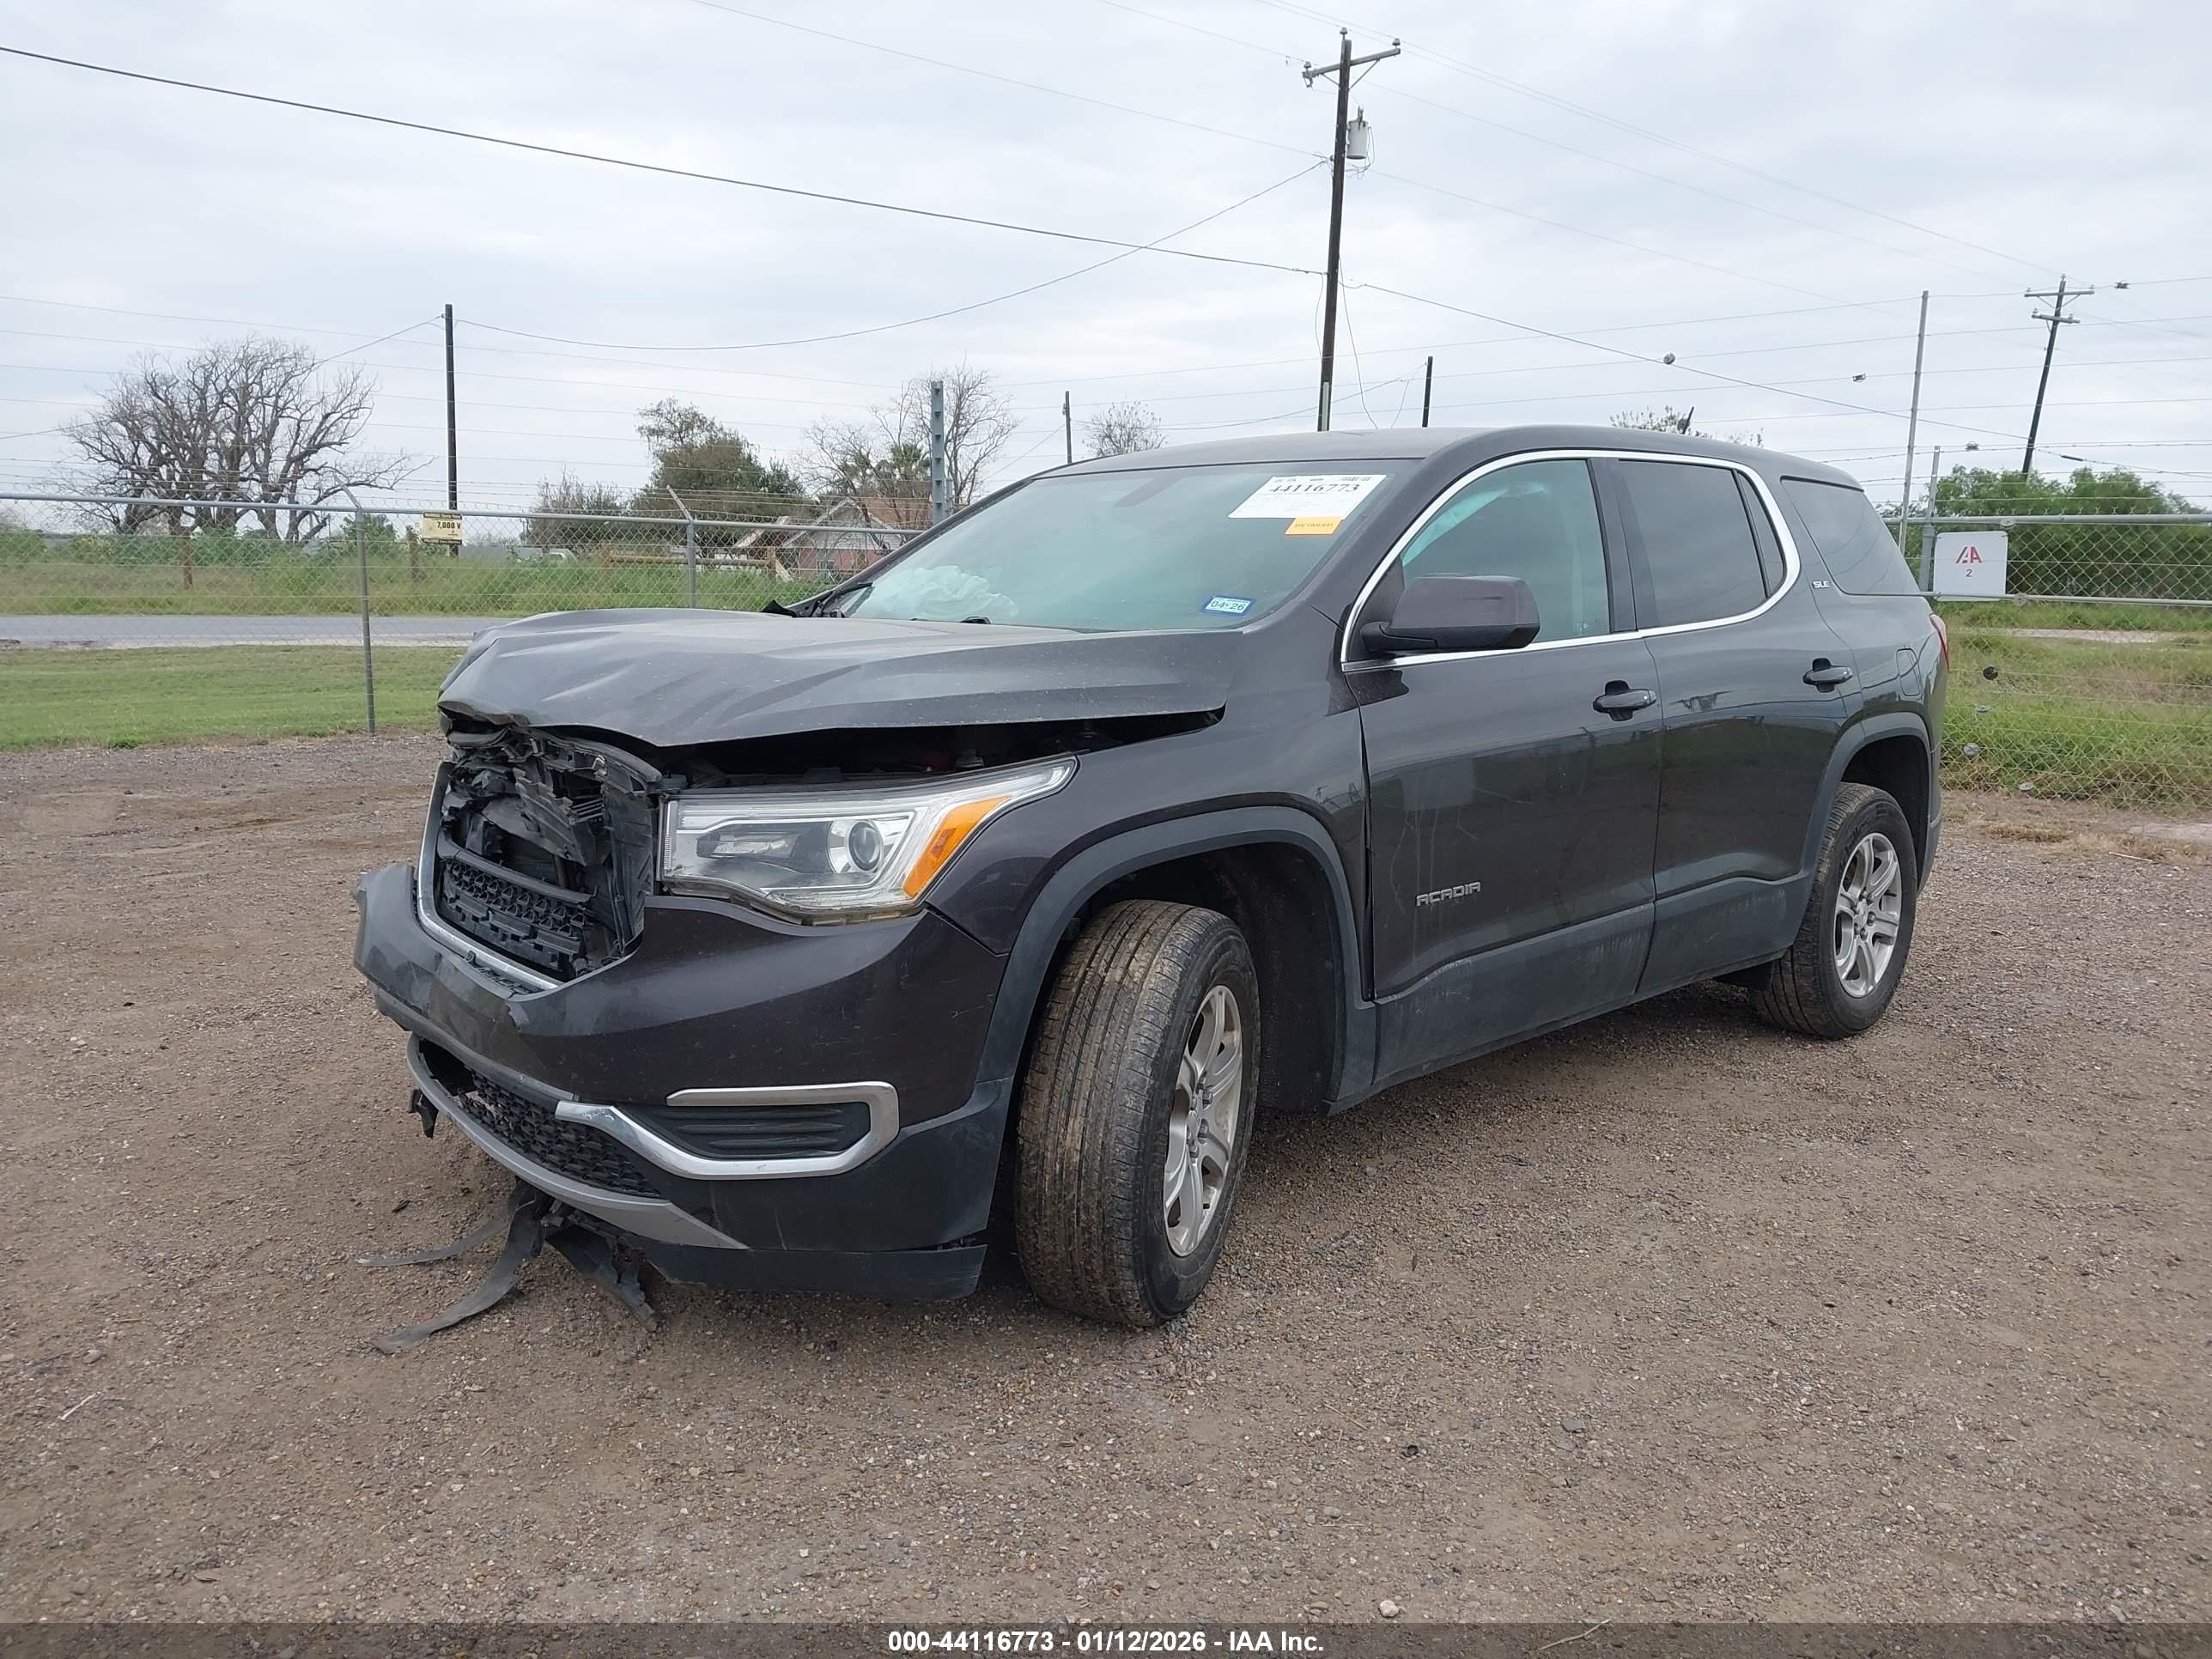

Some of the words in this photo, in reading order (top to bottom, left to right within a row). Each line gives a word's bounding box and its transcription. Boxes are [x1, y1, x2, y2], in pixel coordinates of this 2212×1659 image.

[1268, 483, 1361, 493] 44116773
[1965, 568, 1972, 578] 2
[1416, 881, 1481, 907] ACADIA
